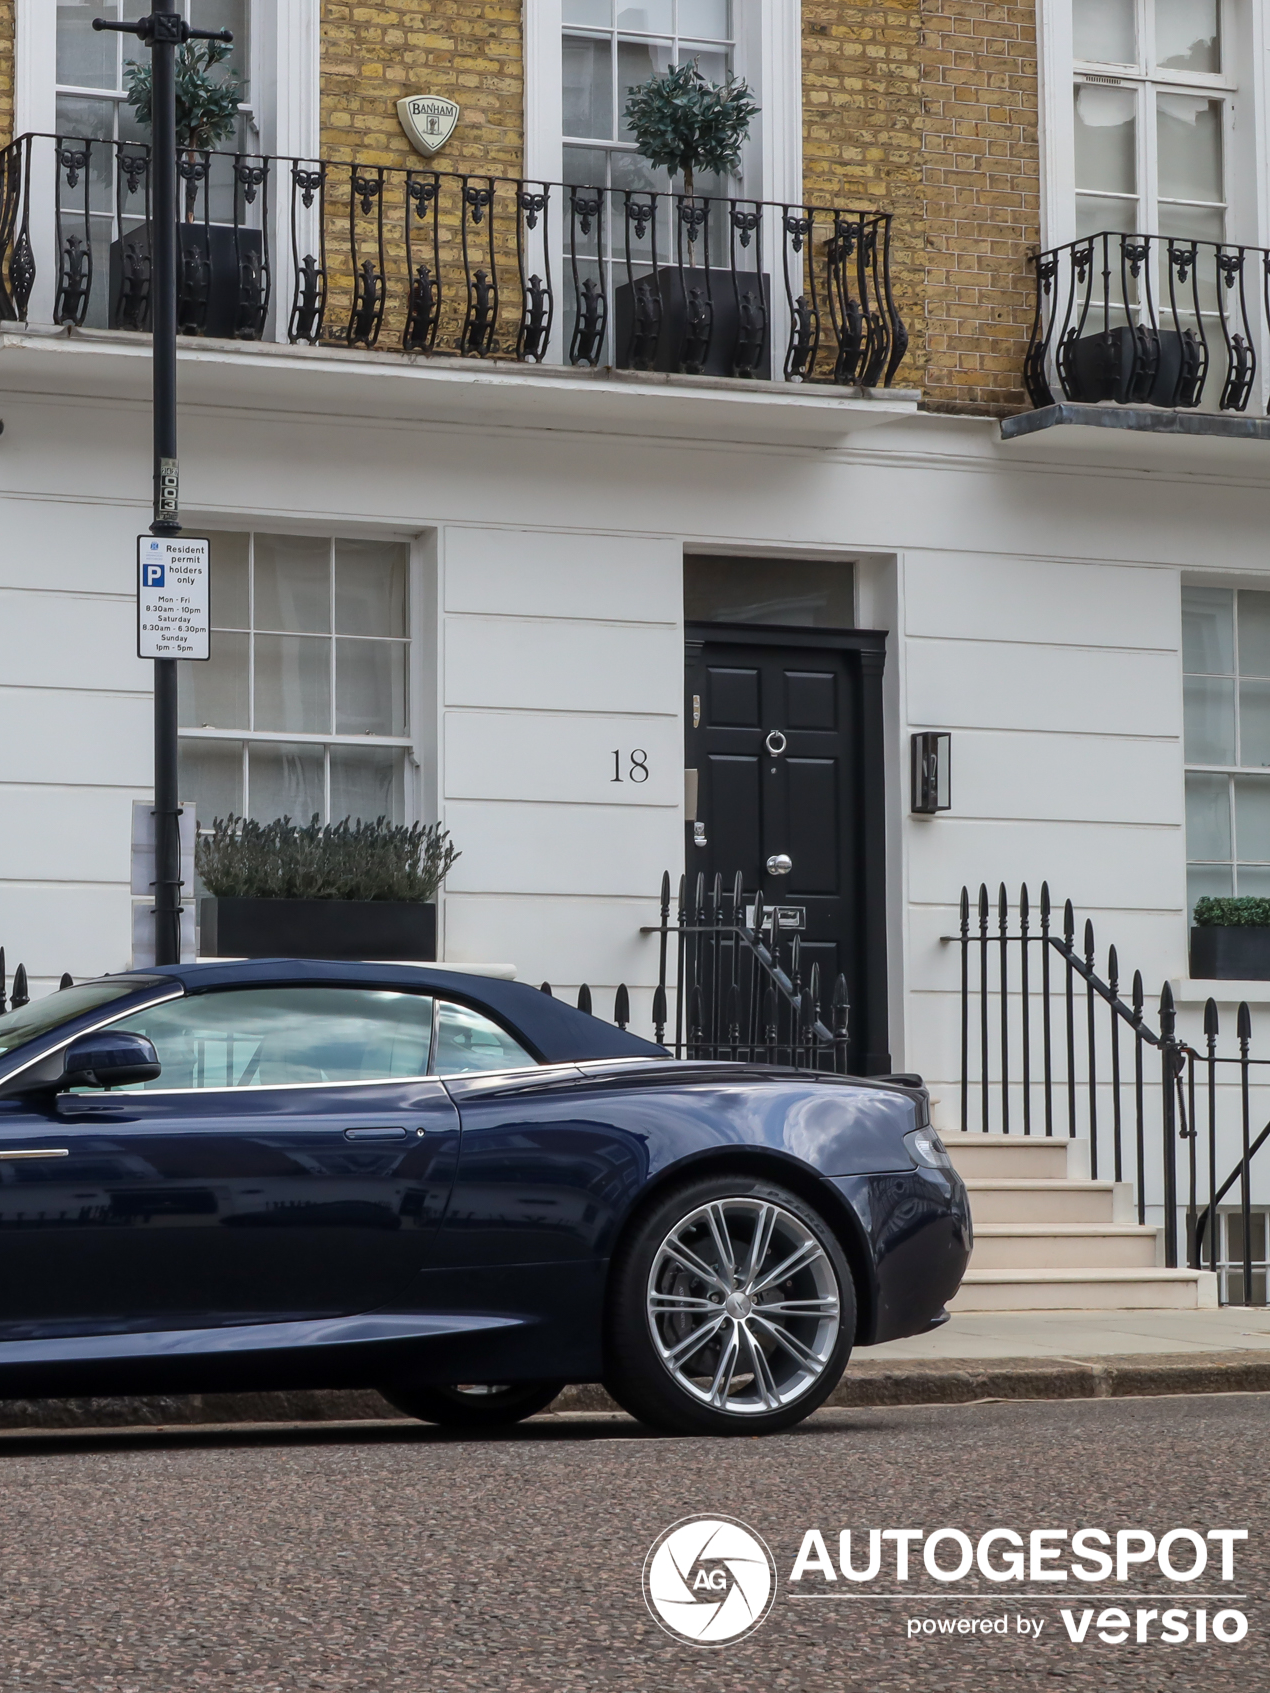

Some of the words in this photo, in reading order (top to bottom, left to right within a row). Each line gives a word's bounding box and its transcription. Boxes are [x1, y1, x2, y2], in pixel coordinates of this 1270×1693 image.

[412, 103, 454, 115] BANHAM
[166, 544, 205, 554] Resident
[171, 556, 201, 564] permit
[147, 565, 162, 586] P
[169, 566, 203, 575] holders
[177, 576, 196, 586] only
[145, 605, 175, 613] 8.30am
[181, 606, 201, 615] 10pm
[157, 615, 191, 624] Saturday
[142, 624, 171, 632] 8.30am
[177, 625, 207, 634] 6.30pm
[161, 634, 188, 643] Sunday
[177, 644, 194, 653] 5pm
[610, 748, 649, 784] 18
[779, 1196, 826, 1234] ZERO
